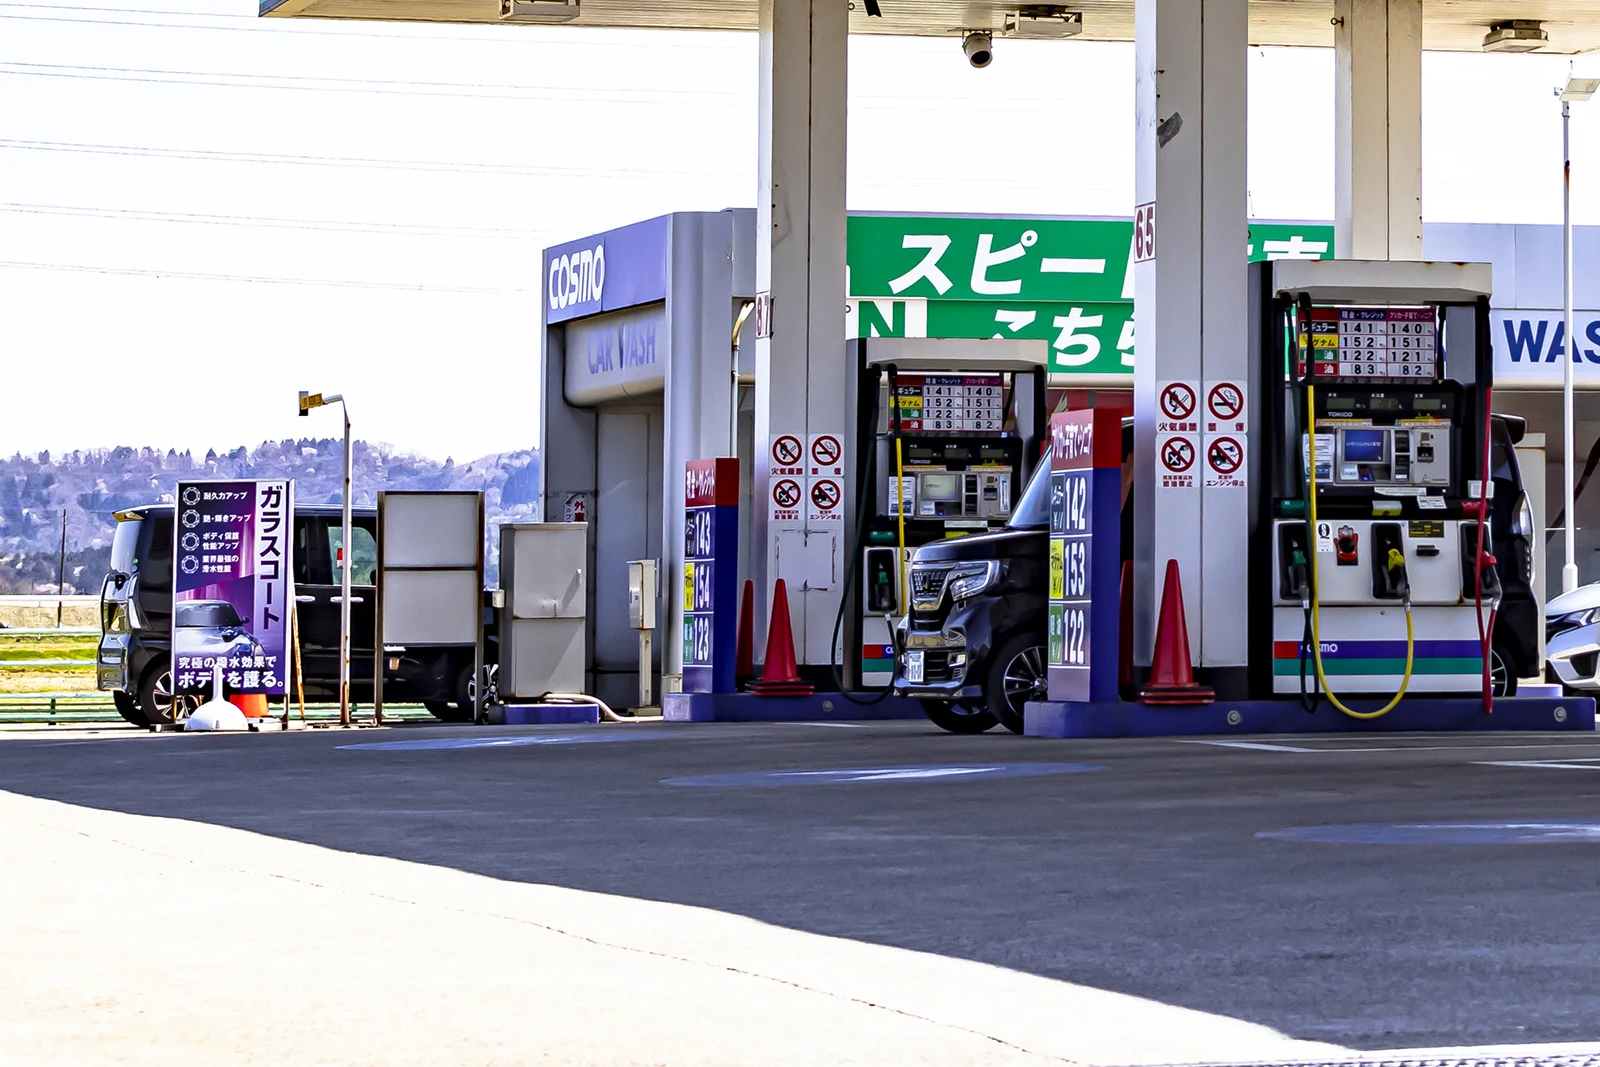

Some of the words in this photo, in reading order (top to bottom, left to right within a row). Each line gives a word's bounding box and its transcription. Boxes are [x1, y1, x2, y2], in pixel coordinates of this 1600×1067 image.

[1136, 207, 1153, 259] 65
[549, 244, 605, 310] COSMO
[588, 328, 613, 375] CAR
[618, 318, 656, 370] WASH
[1343, 322, 1373, 333] 141
[1391, 323, 1423, 333] 140
[1343, 337, 1374, 347] 152
[1391, 337, 1421, 348] 151
[1343, 350, 1374, 361] 122
[1391, 351, 1421, 362] 121
[1354, 364, 1375, 374] 83
[1402, 365, 1422, 375] 82
[926, 387, 952, 396] 141
[967, 387, 992, 396] 140
[926, 398, 952, 407] 152
[967, 398, 991, 407] 151
[926, 409, 952, 418] 122
[966, 410, 991, 418] 121
[935, 421, 952, 430] 83
[975, 421, 992, 430] 82
[1065, 476, 1086, 530] 142
[695, 511, 711, 556] 143
[260, 485, 283, 629] ガラスコート
[1065, 541, 1085, 597] 153
[695, 564, 710, 609] 154
[693, 614, 710, 661] 123
[1063, 609, 1084, 664] 122
[178, 670, 283, 689] ボデを護る。
